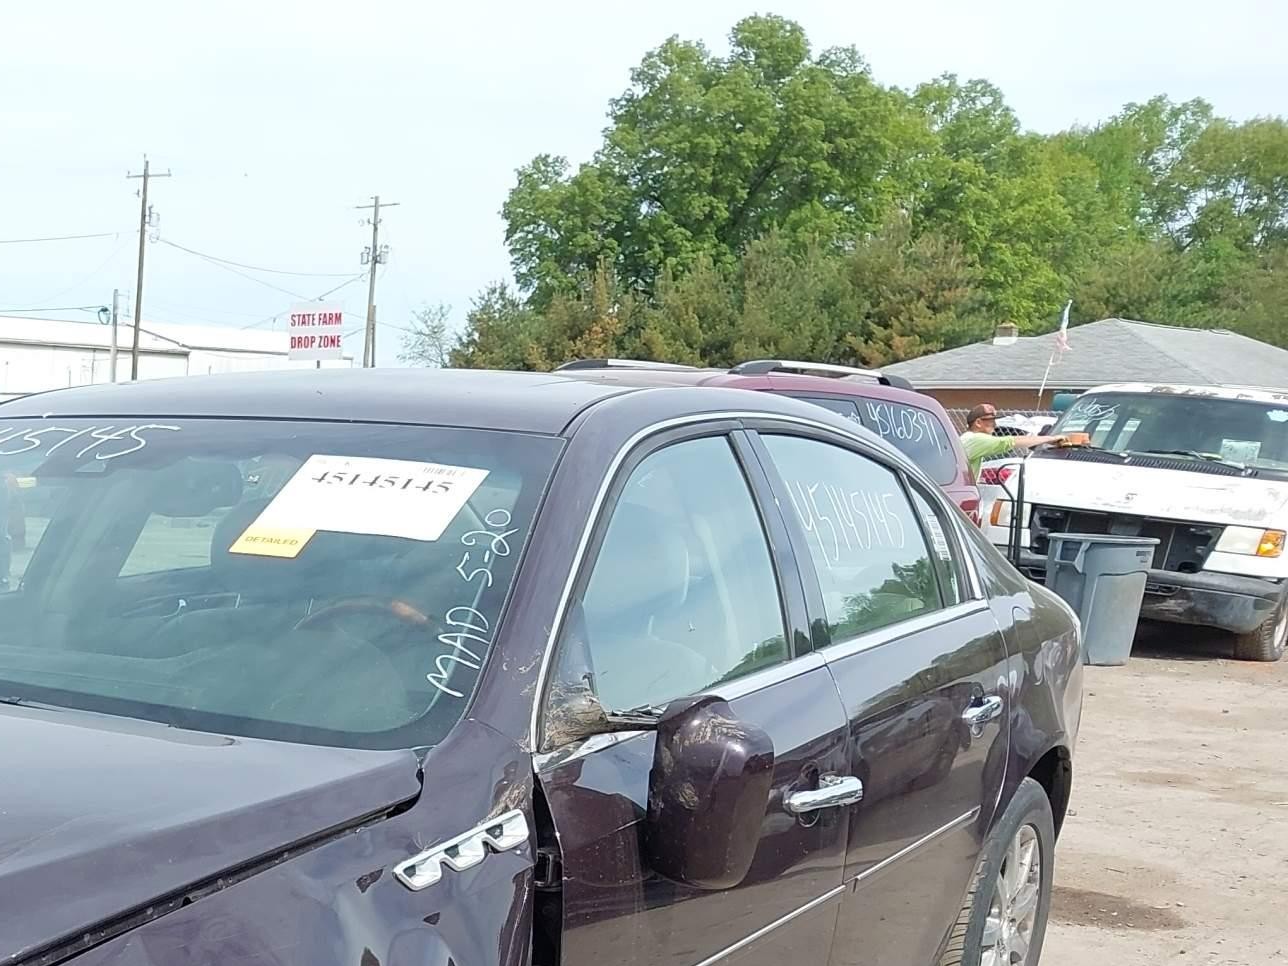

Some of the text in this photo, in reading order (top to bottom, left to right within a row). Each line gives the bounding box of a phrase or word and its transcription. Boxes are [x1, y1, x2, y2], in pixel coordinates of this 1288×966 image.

[290, 312, 342, 327] STATE FARM
[290, 334, 342, 349] DROP ZONE
[866, 402, 943, 458] 45160391
[312, 471, 454, 494] 45145145
[785, 479, 905, 570] 45145145
[244, 536, 299, 546] DETAILED
[426, 508, 520, 698] MAD 5-20
